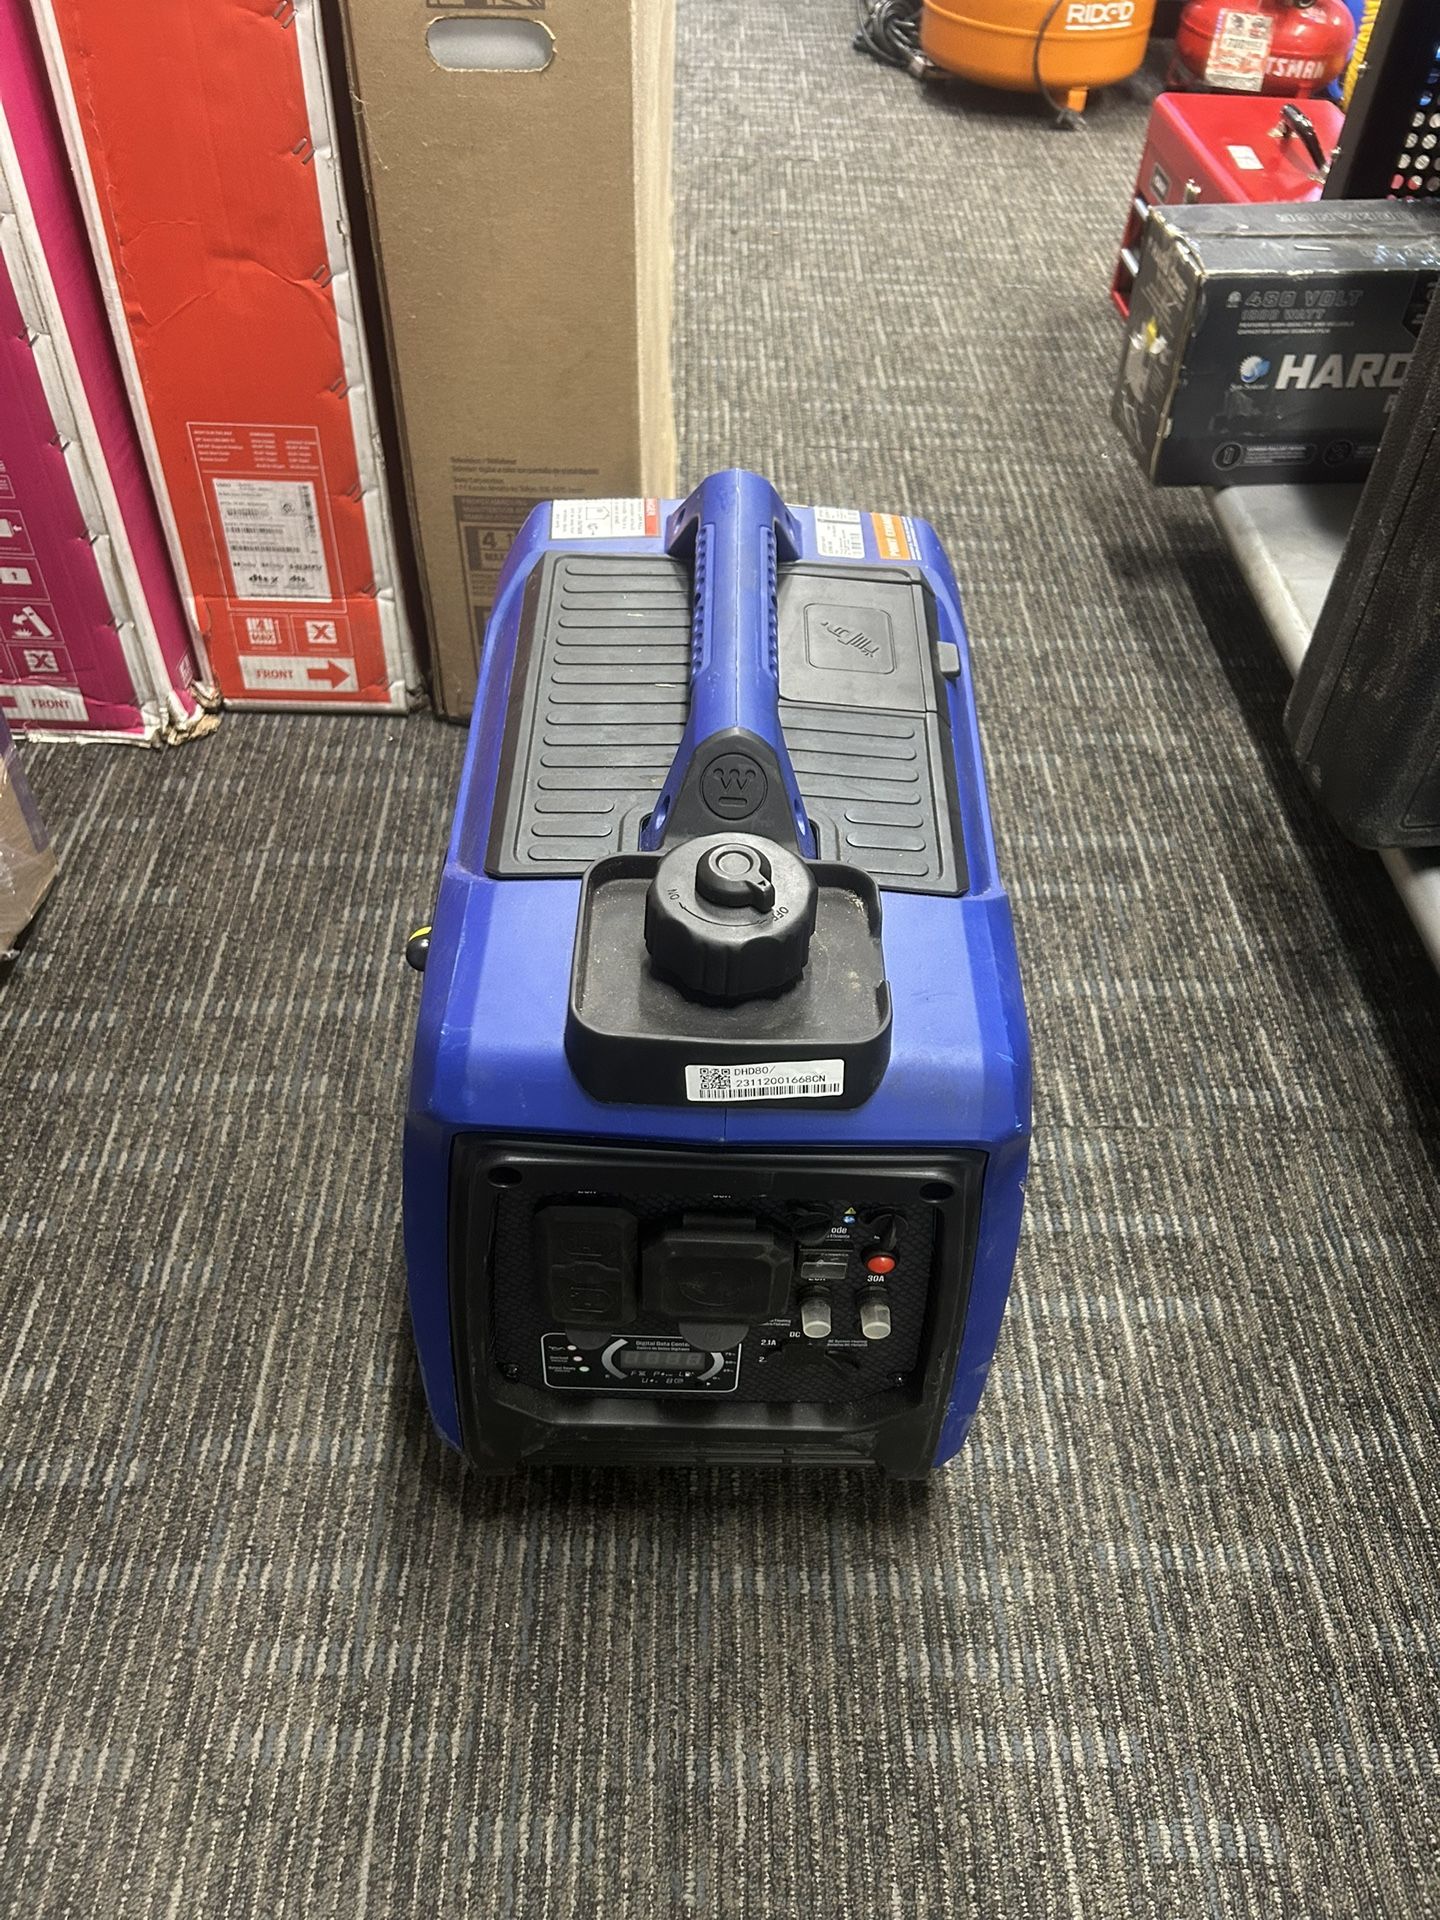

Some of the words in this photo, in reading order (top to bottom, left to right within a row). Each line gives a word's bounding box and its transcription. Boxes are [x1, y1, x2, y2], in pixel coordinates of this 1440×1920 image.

[1266, 56, 1326, 79] TSMAN
[1304, 290, 1364, 307] VOLT
[1284, 309, 1326, 320] WATT
[255, 668, 293, 680] FRONT
[32, 698, 71, 710] FRONT
[734, 1065, 776, 1076] DHD80/
[736, 1075, 826, 1088] 23112001668CN
[831, 1226, 848, 1234] ode
[635, 1340, 655, 1348] Digital
